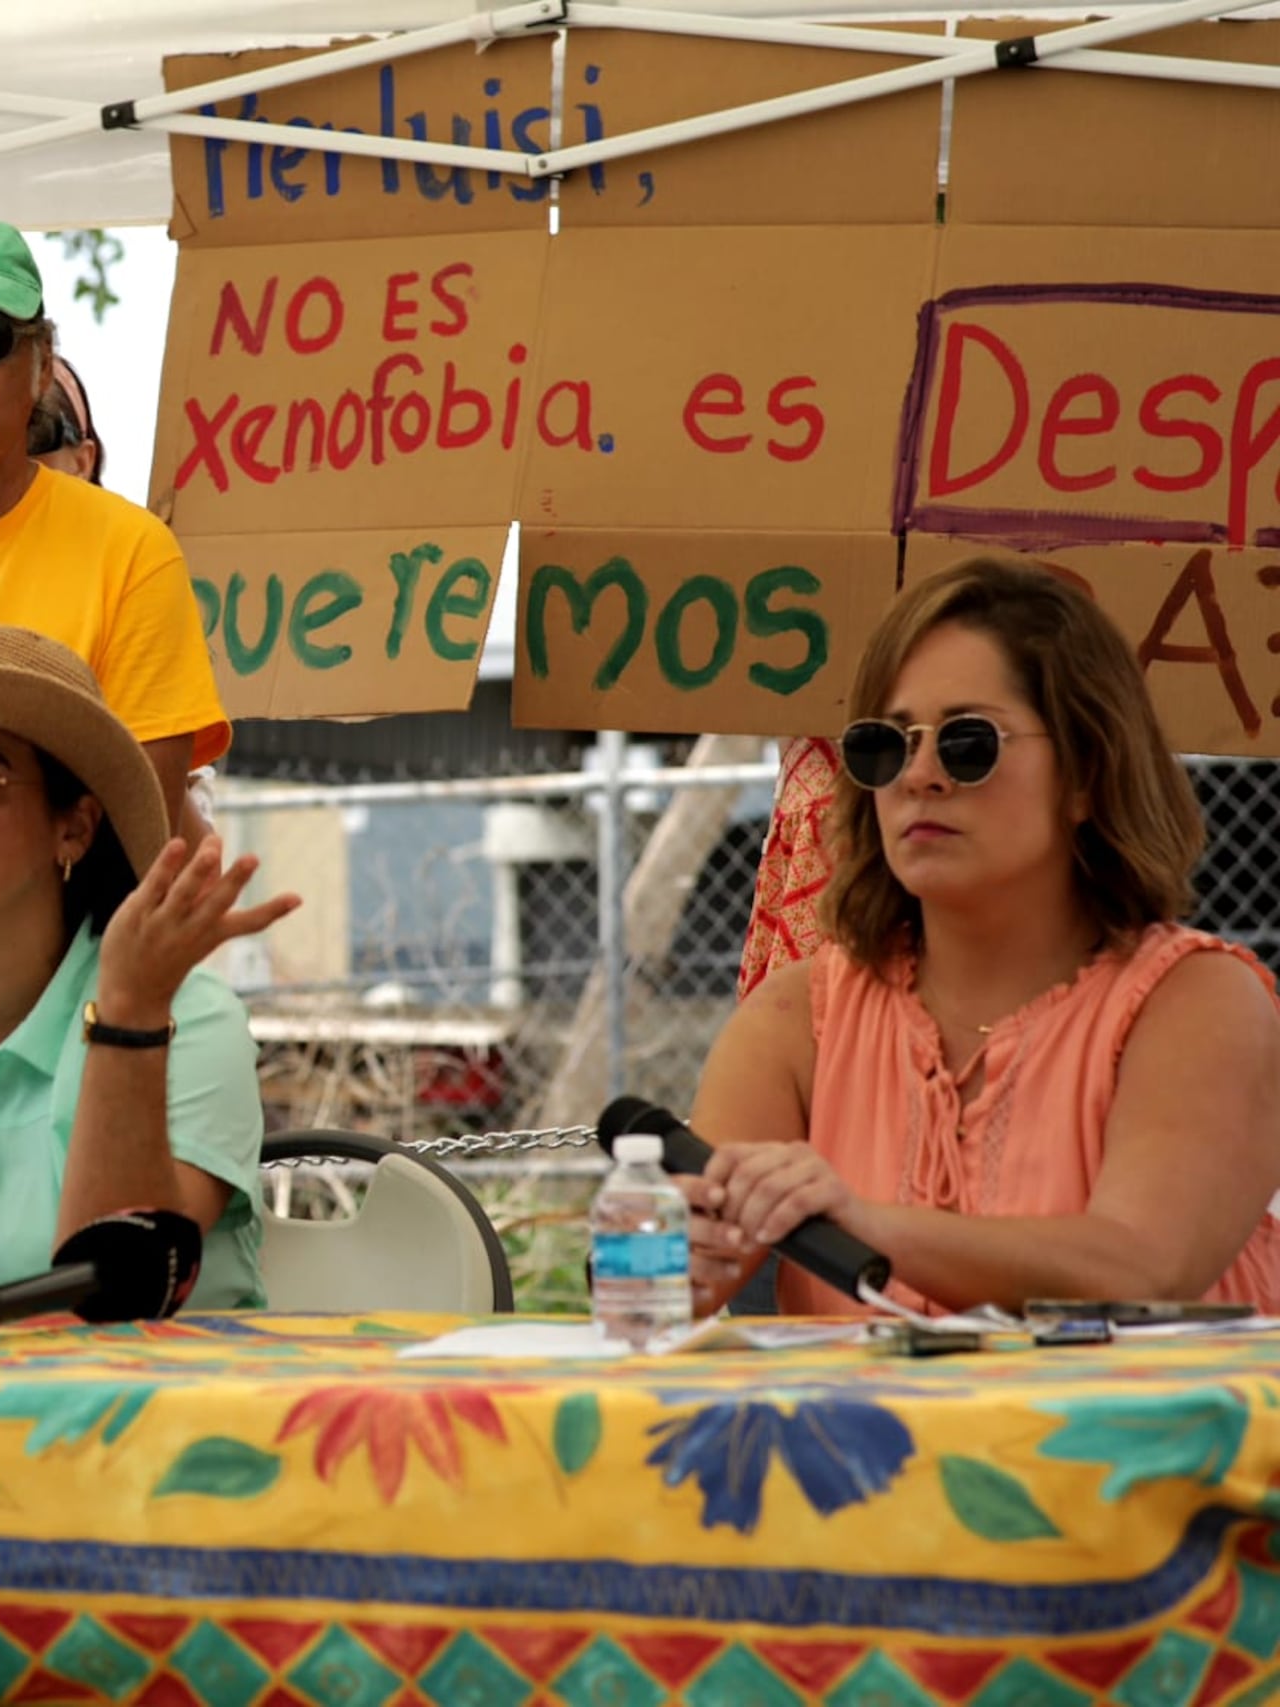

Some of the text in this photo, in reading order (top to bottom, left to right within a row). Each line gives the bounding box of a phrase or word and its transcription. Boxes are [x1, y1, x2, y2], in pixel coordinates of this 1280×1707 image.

[209, 262, 473, 357] NO ES
[683, 373, 825, 462] es
[929, 322, 1280, 553] Desp
